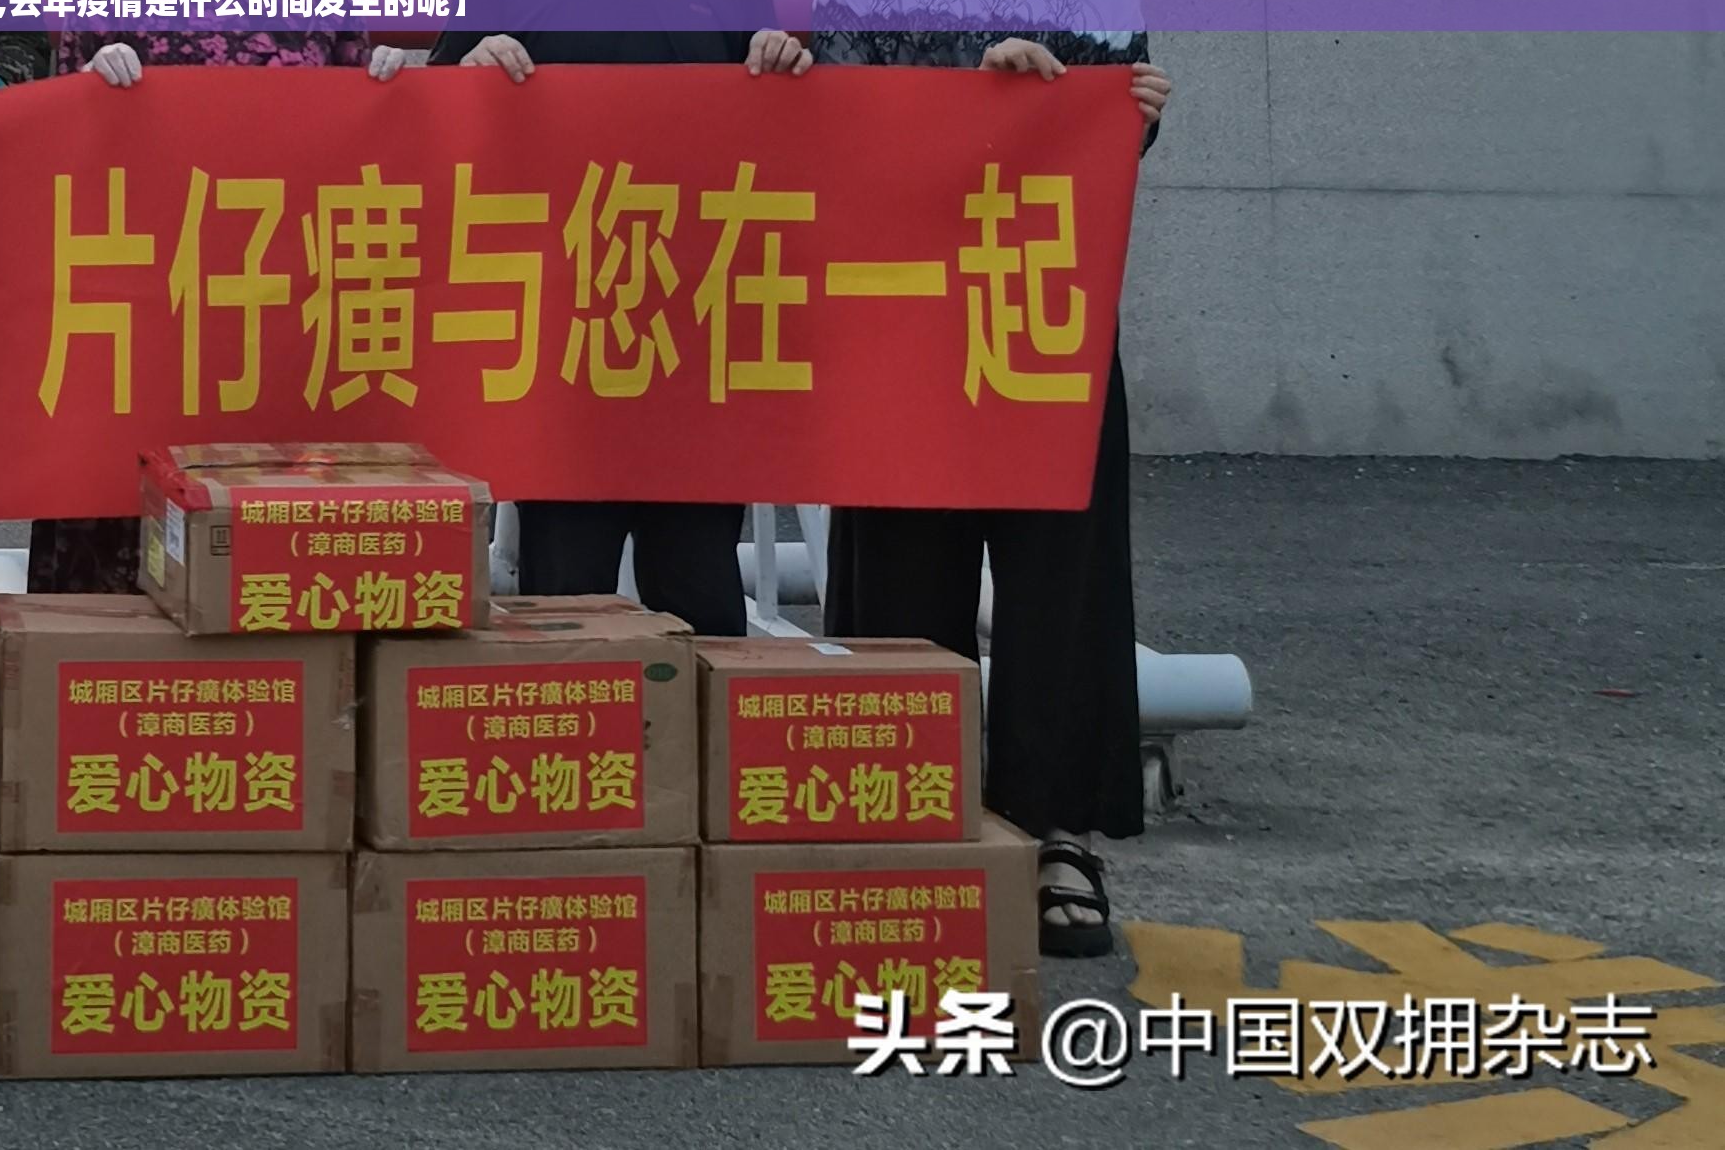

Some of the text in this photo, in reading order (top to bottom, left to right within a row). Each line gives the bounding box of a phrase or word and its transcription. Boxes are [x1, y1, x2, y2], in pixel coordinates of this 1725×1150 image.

[38, 160, 1092, 418] 片仔癀与您在一起
[242, 500, 462, 523] 城厢区片仔癀体验馆
[239, 571, 463, 631] 爱心物资
[69, 679, 294, 703] 城厢区片仔癀体验馆
[418, 679, 633, 708] 城厢区片仔癀体验馆
[738, 692, 951, 717] 城厢区片仔癀体验馆
[66, 752, 295, 813] 爱心物资
[418, 751, 635, 816] 爱心物资
[738, 762, 953, 824] 爱心物资
[65, 897, 290, 922] 城厢区片仔癀体验馆
[416, 895, 635, 921] 城厢区片仔癀体验馆
[764, 886, 979, 913] 城厢区片仔癀体验馆
[61, 969, 290, 1034] 爱心物资
[416, 967, 637, 1032] 爱心物资
